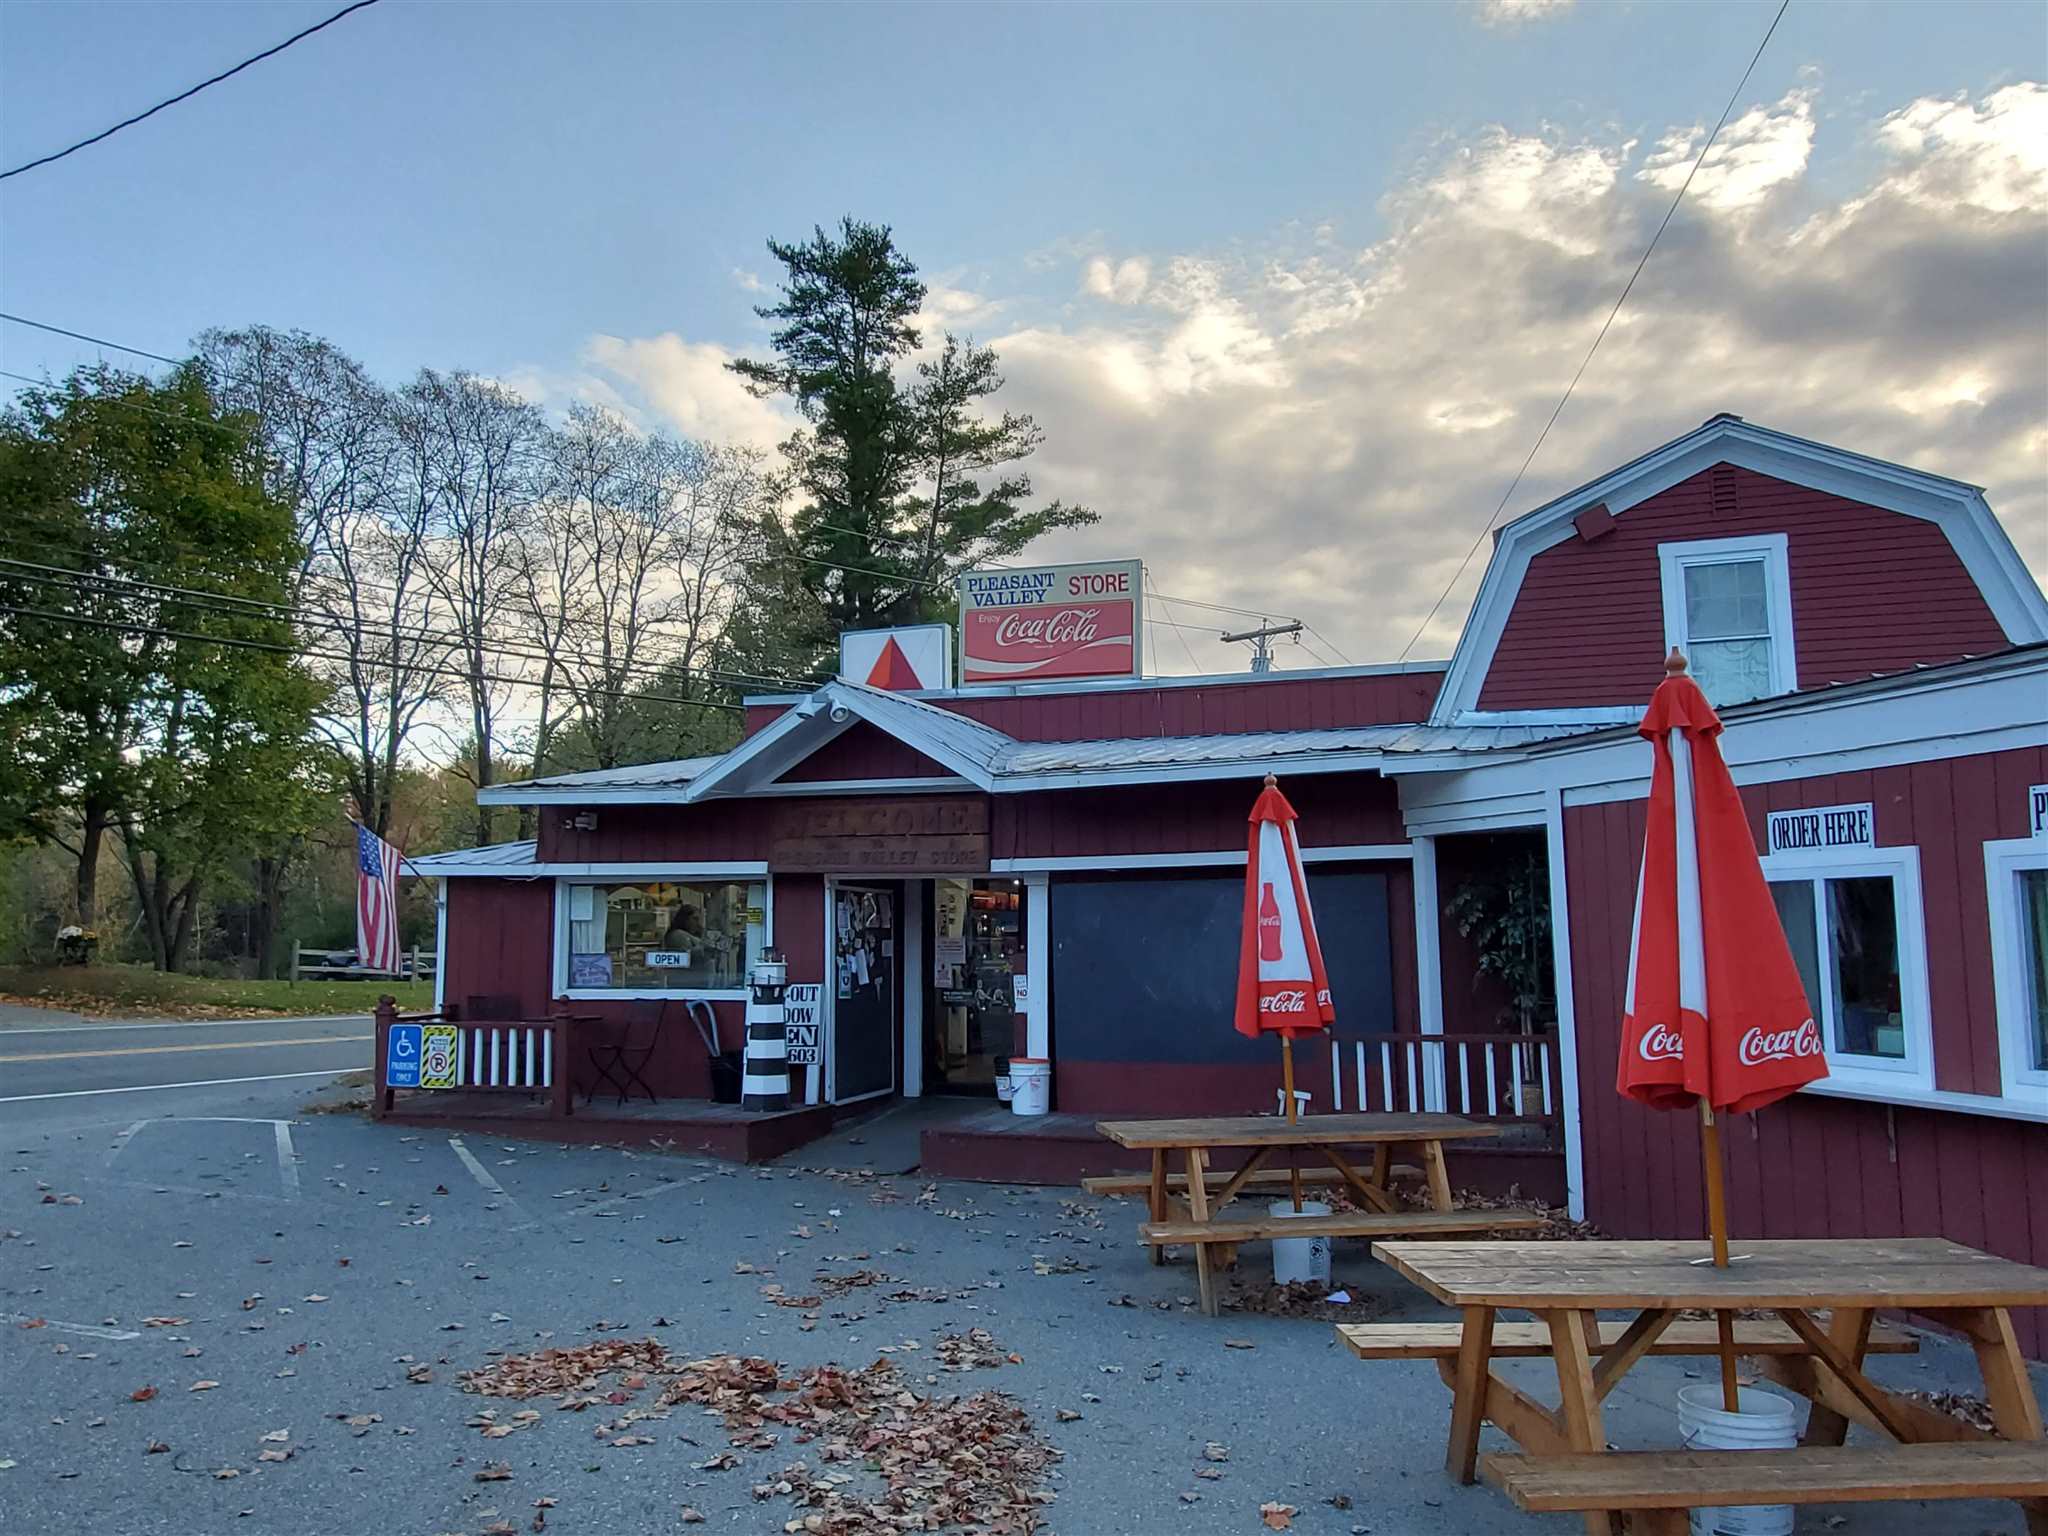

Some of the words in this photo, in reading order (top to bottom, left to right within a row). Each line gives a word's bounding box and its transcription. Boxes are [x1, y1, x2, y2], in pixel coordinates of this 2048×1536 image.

[968, 572, 1055, 592] PLEASANT
[1068, 573, 1129, 596] STORE
[972, 589, 1047, 607] VALLEY
[1772, 813, 1821, 850] ORDER
[1824, 809, 1869, 846] HERE
[654, 954, 680, 965] OPEN
[784, 1008, 814, 1023] DOW
[786, 1026, 817, 1046] EN
